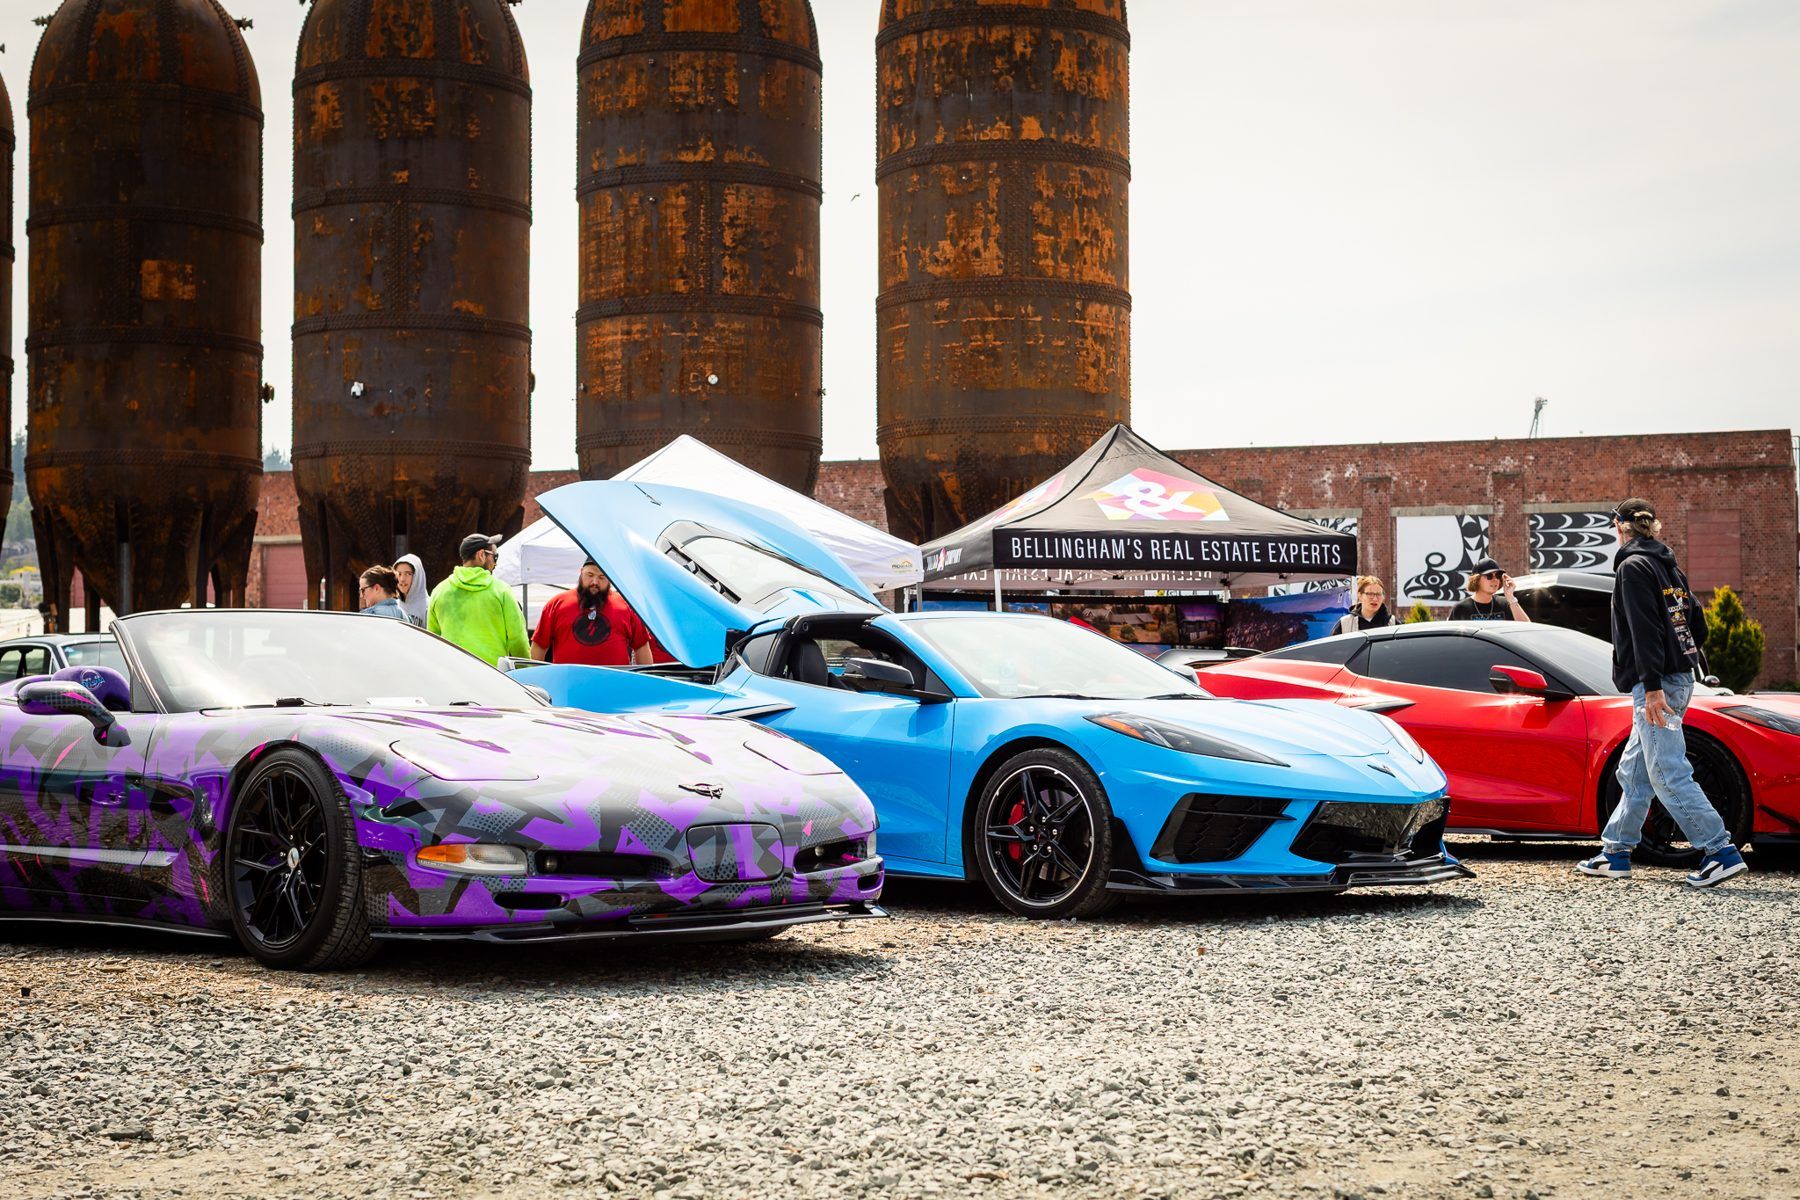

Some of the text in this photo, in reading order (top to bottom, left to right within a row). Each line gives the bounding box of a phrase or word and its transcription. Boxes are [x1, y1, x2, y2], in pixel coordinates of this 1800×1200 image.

[1011, 537, 1341, 566] BELLINGHAM'S REAL ESTATE EXPERTS
